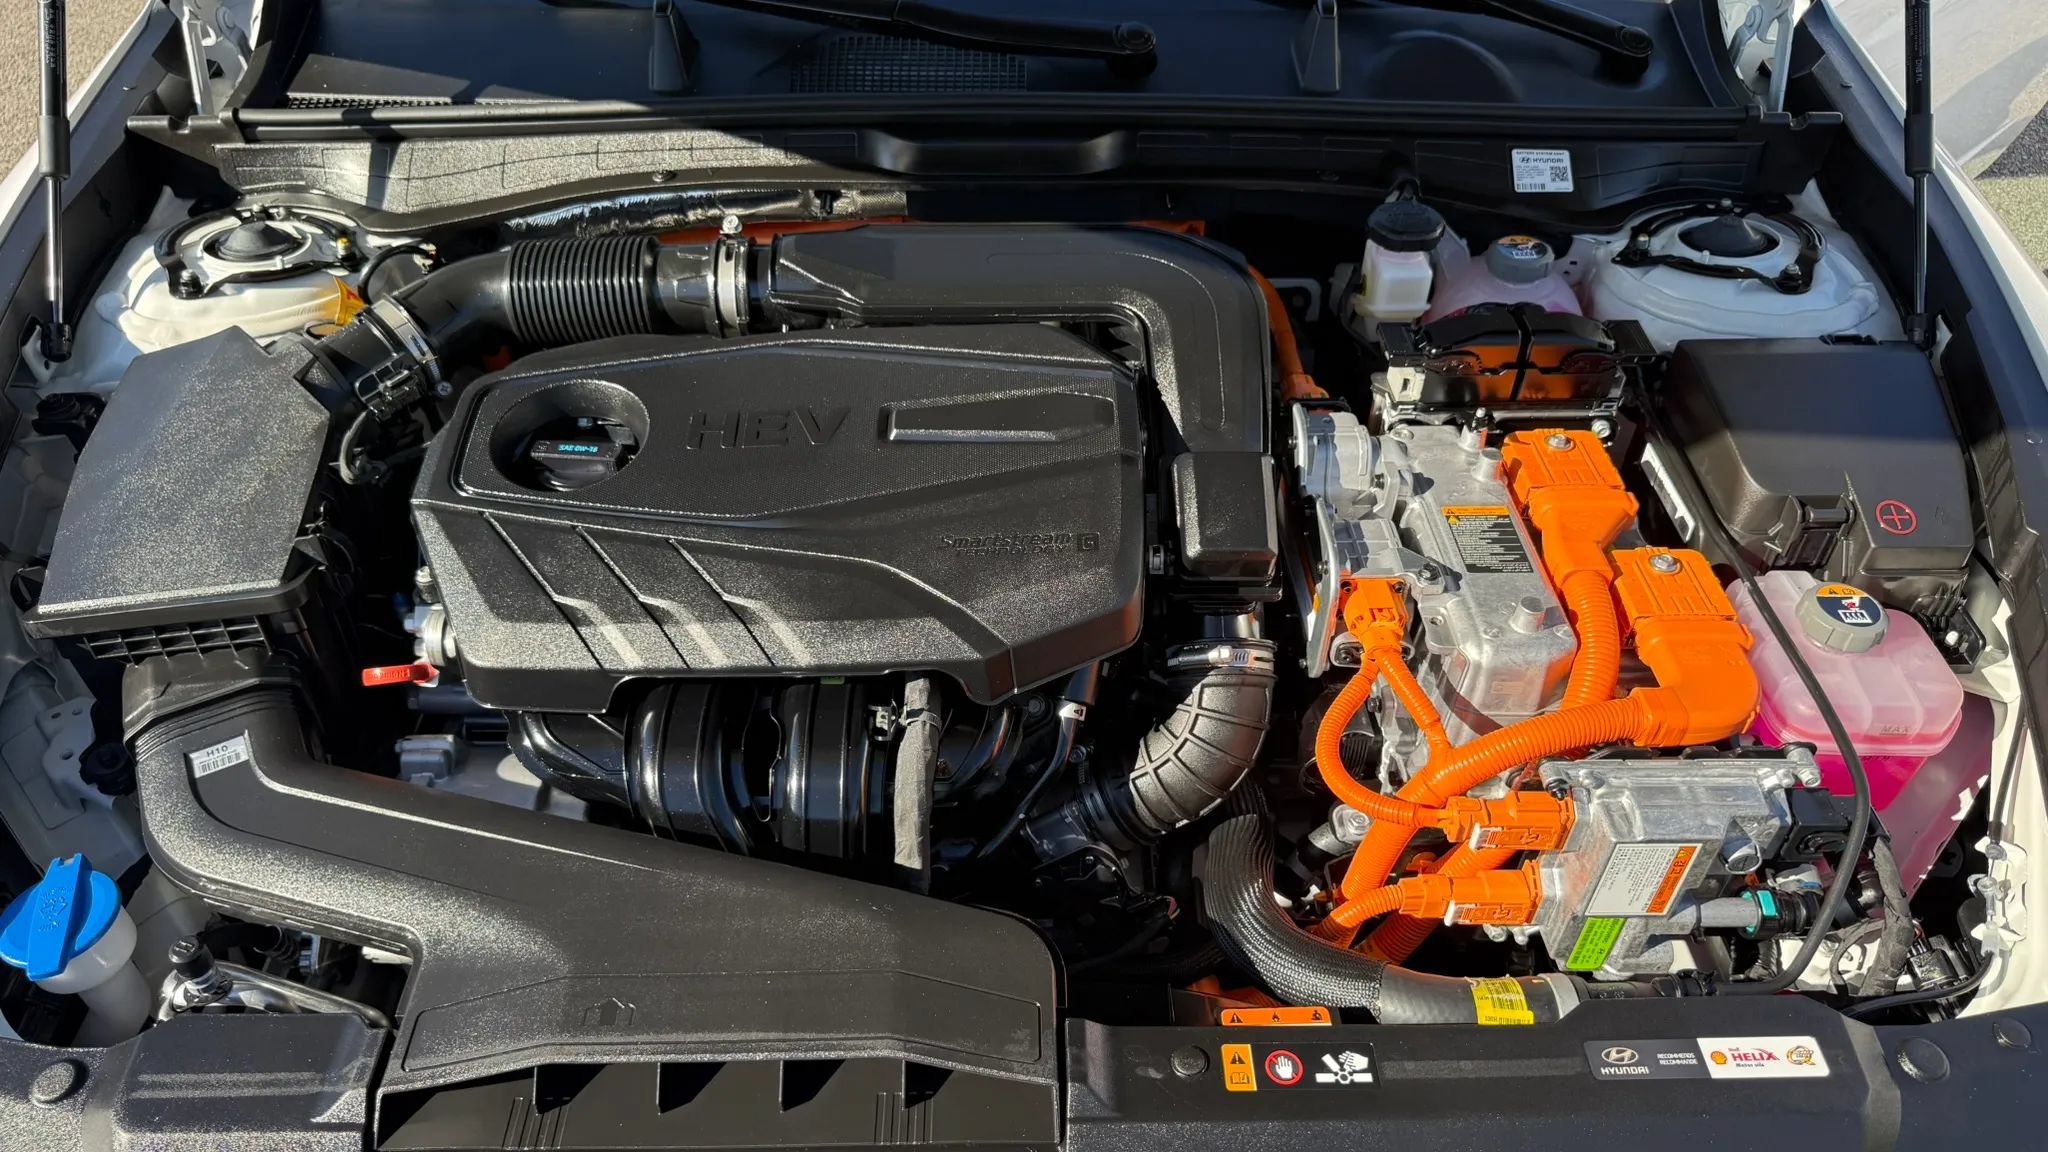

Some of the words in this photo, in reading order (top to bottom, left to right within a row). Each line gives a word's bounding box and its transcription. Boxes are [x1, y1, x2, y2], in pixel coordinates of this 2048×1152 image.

[686, 408, 850, 449] HEV
[937, 532, 1072, 548] Smartstream
[1880, 725, 1909, 733] MAX
[206, 744, 228, 757] H10
[1731, 1051, 1778, 1061] HELIX
[1601, 1066, 1650, 1075] HYUNDAI
